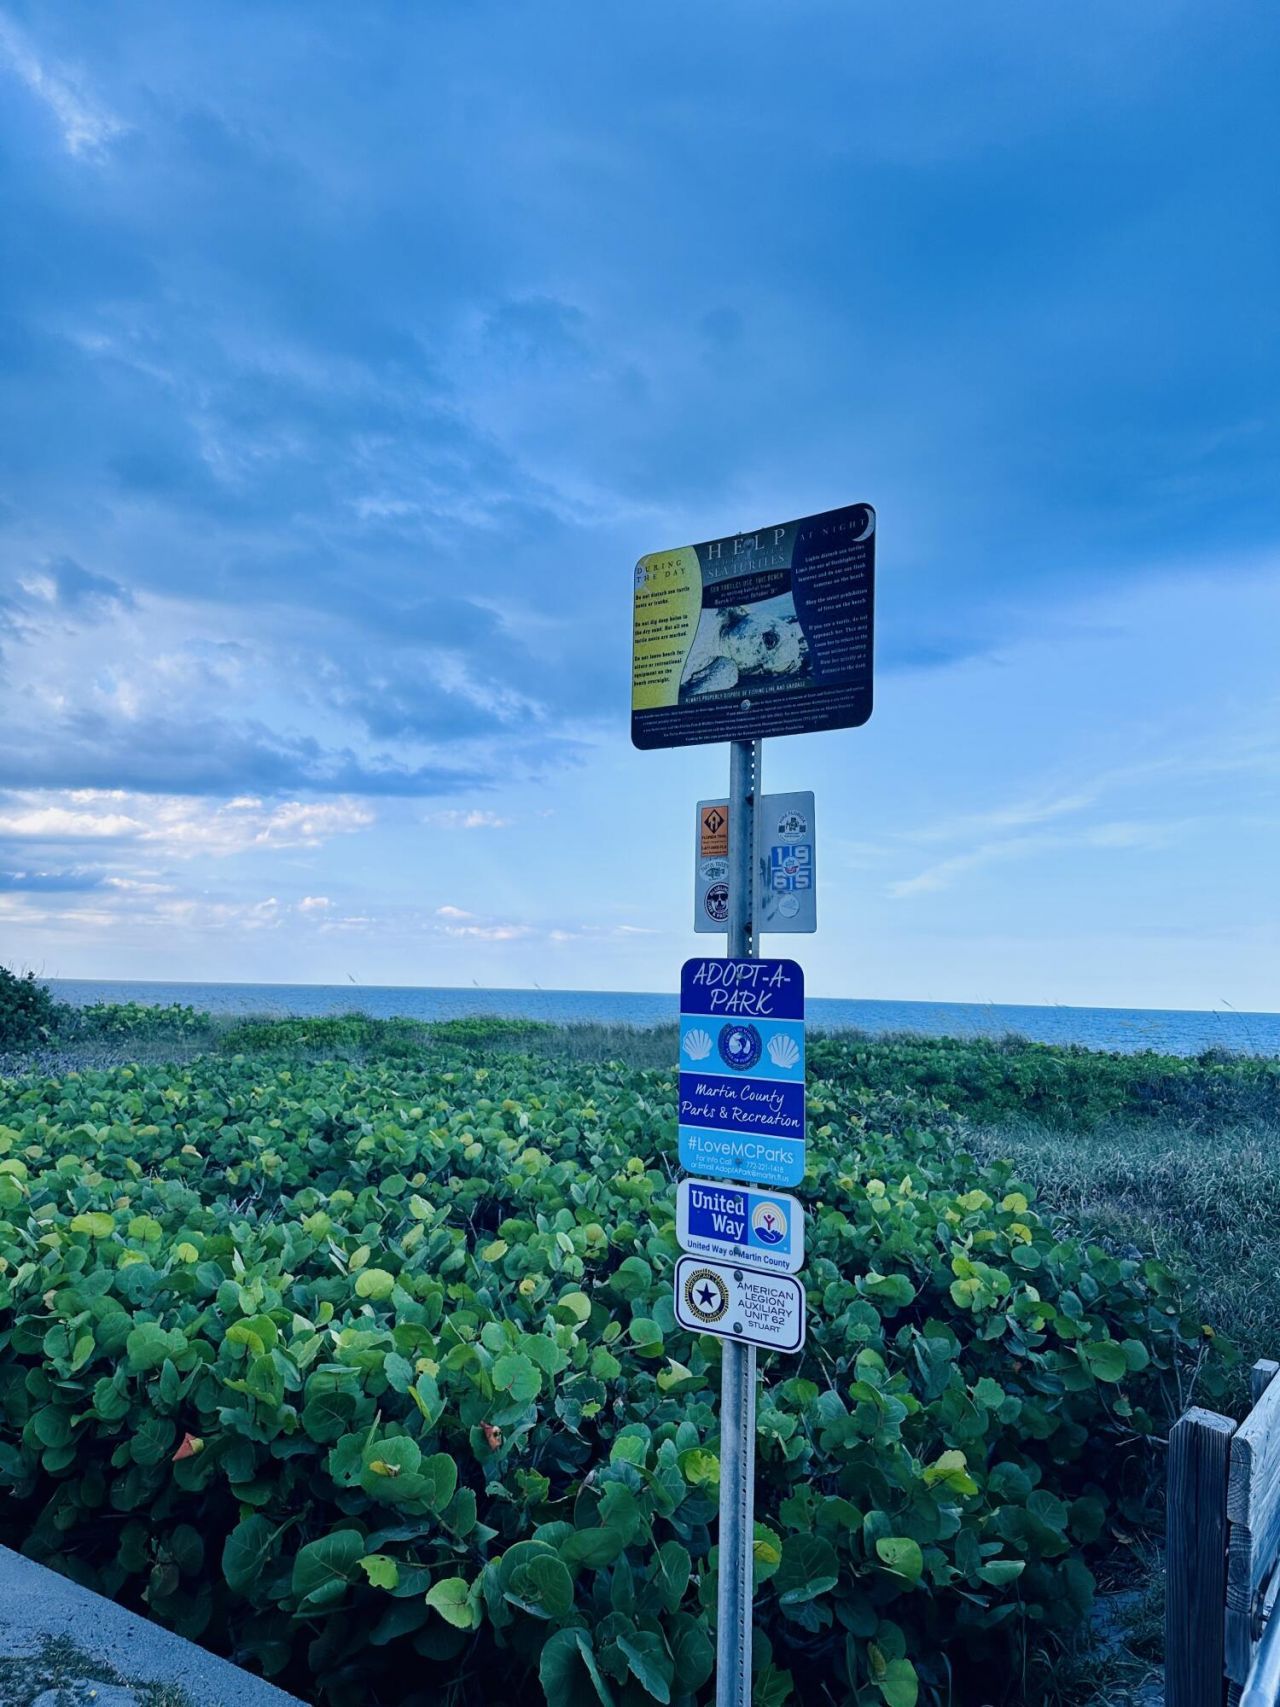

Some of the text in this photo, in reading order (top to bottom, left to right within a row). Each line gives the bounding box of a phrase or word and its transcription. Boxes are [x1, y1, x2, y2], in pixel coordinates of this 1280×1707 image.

[707, 528, 785, 560] HELP
[636, 559, 682, 575] DURING
[636, 567, 686, 583] THE DAY
[710, 988, 774, 1016] PARK
[695, 1083, 784, 1112] Martin County
[681, 1101, 800, 1128] Parks & Recreation
[688, 1135, 794, 1164] #LoveMCParks
[719, 1157, 732, 1165] Call
[691, 1190, 745, 1216] United
[712, 1213, 745, 1240] Way
[687, 1240, 711, 1252] United
[712, 1244, 727, 1256] Way
[737, 1250, 762, 1263] Martin
[763, 1256, 790, 1270] County
[737, 1282, 794, 1301] AMERICAN
[745, 1292, 785, 1308] LEGION
[738, 1299, 793, 1318] AUXILIARY
[744, 1309, 785, 1326] UNIT 62
[748, 1320, 781, 1333] STUART
